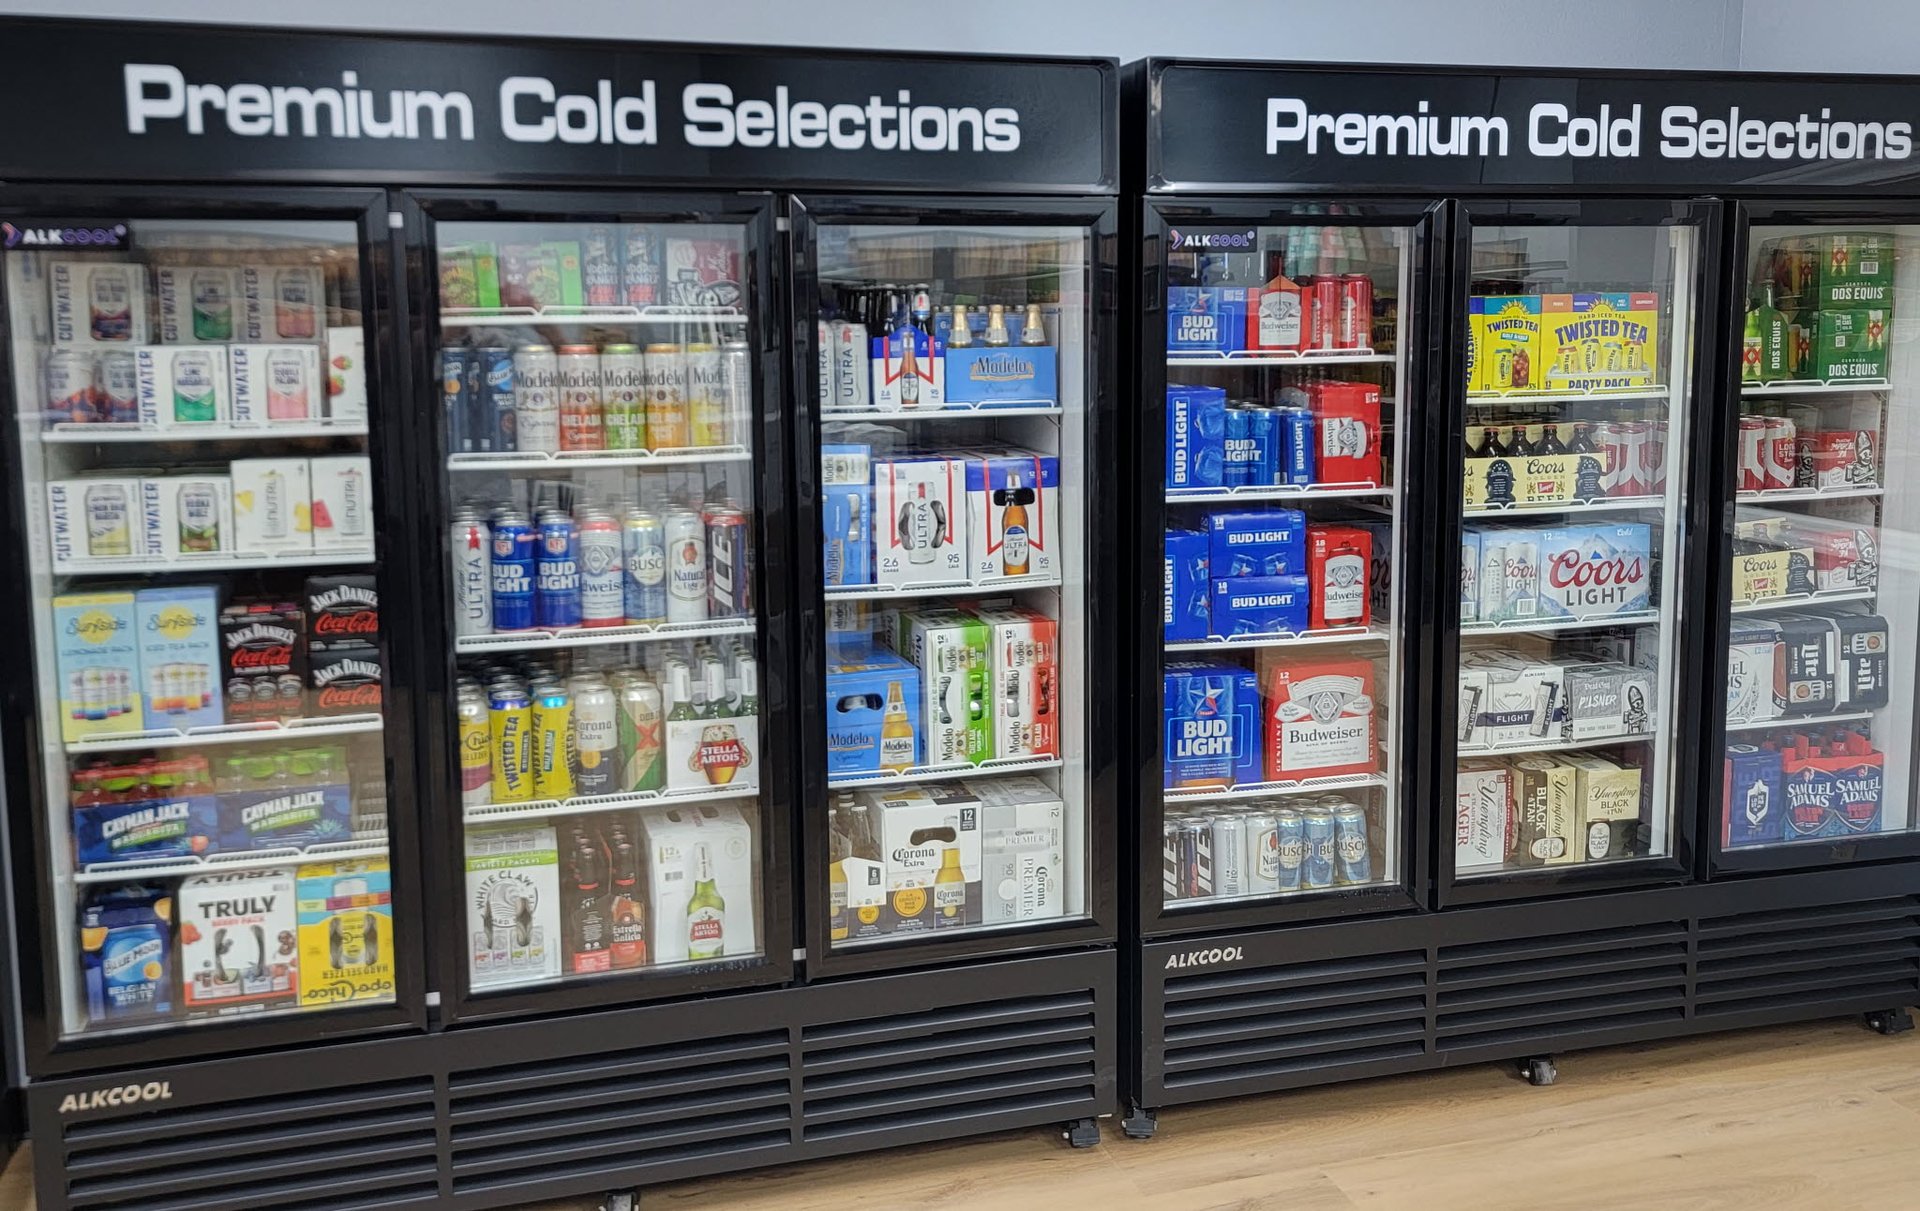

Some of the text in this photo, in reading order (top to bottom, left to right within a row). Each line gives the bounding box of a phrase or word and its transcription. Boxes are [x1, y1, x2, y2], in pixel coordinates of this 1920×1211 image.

[123, 63, 1021, 152] Premium Cold Selections
[1266, 97, 1912, 160] Premium Cold Selections
[1184, 233, 1250, 247] ALKCOOL
[1832, 287, 1884, 300] DOS EQUIS
[54, 265, 72, 341] CUTWATER
[161, 270, 178, 341] CUTWATER
[247, 268, 262, 340] CUTWATER
[1182, 315, 1214, 328] BUD
[1261, 320, 1300, 331] Budweiser
[1486, 319, 1540, 334] TWISTED TEA
[1177, 327, 1218, 342] LIGHT
[1555, 319, 1648, 346] TWISTED TEA
[1771, 321, 1781, 370] DOS EQUIS
[843, 348, 854, 398] ULTRA
[977, 356, 1027, 374] Modelo
[1829, 363, 1878, 377] DOS EQUIS
[1568, 377, 1632, 390] PARTY PACK
[1174, 400, 1188, 484] BUD LIGHT
[1225, 439, 1256, 451] BUD
[1295, 421, 1305, 471] BUD LIGHT
[1526, 458, 1566, 475] Coors
[917, 502, 928, 549] ULTRA
[1214, 517, 1225, 526] 18
[1229, 531, 1290, 544] BUD LIGHT
[1315, 539, 1326, 547] 18
[1543, 532, 1552, 541] 12
[1004, 541, 1028, 550] ULTRA
[883, 558, 899, 568] 2.6
[947, 553, 960, 563] 95
[981, 561, 994, 570] 2.6
[1039, 556, 1049, 565] 95
[1743, 557, 1778, 573] Coors
[539, 561, 576, 576] BUD
[711, 530, 734, 609] ICE
[1548, 549, 1644, 589] Coors
[468, 557, 483, 620] ULTRA
[1165, 558, 1174, 624] BUD LIGHT
[1217, 581, 1228, 589] 18
[309, 588, 341, 614] JACK
[1232, 594, 1293, 608] BUD LIGHT
[1565, 586, 1628, 607] LIGHT
[225, 625, 254, 649] JACK
[937, 635, 945, 645] 12
[1006, 629, 1012, 639] 12
[1843, 644, 1850, 654] 12
[1802, 643, 1820, 677] Lite
[313, 662, 344, 688] JACK
[1279, 671, 1290, 680] 12
[1857, 657, 1876, 692] Lite
[1826, 680, 1833, 689] 12
[1578, 694, 1617, 710] PILSNER
[1468, 703, 1478, 731] FLIGHT
[1496, 713, 1529, 723] FLIGHT
[1544, 698, 1555, 726] FLIGHT
[1009, 721, 1021, 754] Modelo
[1183, 719, 1228, 739] BUD
[1288, 726, 1363, 745] Budweiser
[829, 733, 869, 746] Modelo
[942, 727, 954, 761] Modelo
[1176, 736, 1233, 758] LIGHT
[502, 716, 522, 791] TWISTED TEA
[701, 744, 740, 757] STELLA
[701, 753, 741, 765] ARTOIS
[1589, 785, 1638, 802] Yuengling
[1787, 782, 1835, 799] SAMUEL
[1835, 776, 1882, 794] SAMUEL
[1552, 774, 1569, 837] Yuengling
[1600, 799, 1629, 809] BLACK
[1790, 795, 1831, 811] ADAMS
[1839, 790, 1879, 806] ADAMS
[241, 791, 325, 826] CAYMAN JACK
[963, 809, 974, 821] 12
[1050, 807, 1059, 818] 12
[1535, 787, 1546, 832] BLACK
[102, 802, 190, 840] CAYMAN JACK
[1457, 793, 1471, 847] LAGER
[1475, 777, 1499, 859] Yuengling
[1005, 835, 1045, 845] PREMIER
[1336, 838, 1368, 853] BUSCH
[892, 847, 936, 863] Corona
[1197, 832, 1213, 894] ICE
[903, 860, 925, 868] Extra
[1005, 863, 1014, 876] 90
[1163, 832, 1178, 898] ICE
[475, 870, 534, 911] WHITE CLAW
[936, 889, 964, 901] Corona
[1023, 858, 1034, 917] PREMIER
[1035, 866, 1048, 907] Corona
[199, 895, 277, 920] TRULY
[612, 924, 643, 935] Estrella
[693, 922, 720, 932] STELLA
[612, 932, 643, 943] Galicia
[103, 938, 162, 977] BLUE MOON
[1165, 946, 1244, 970] ALKCOOL
[57, 1082, 174, 1113] ALKCOOL
